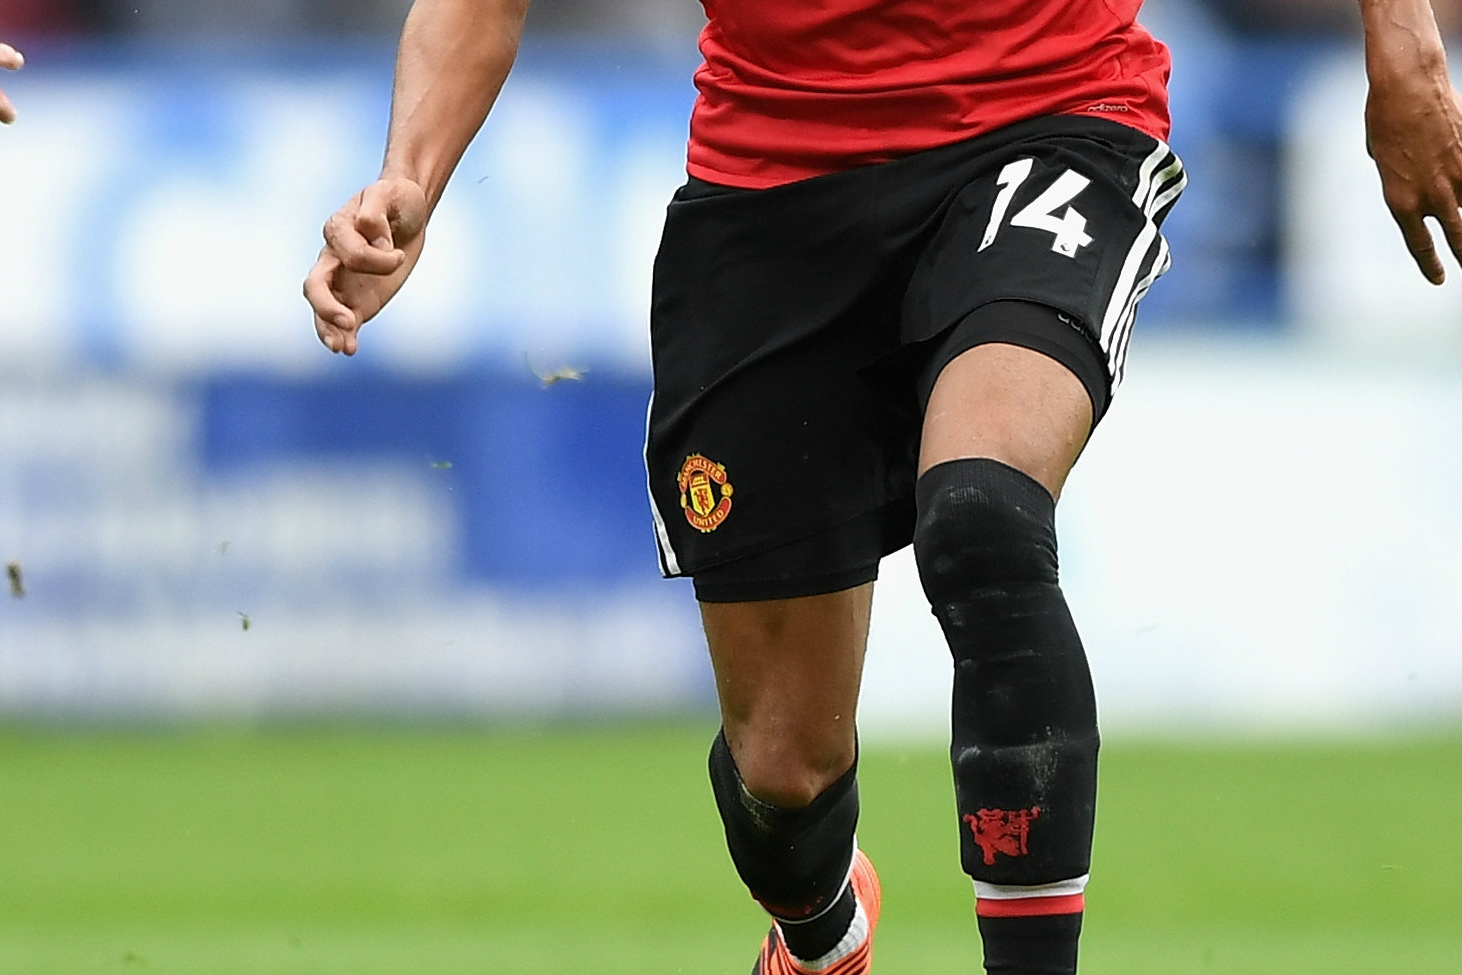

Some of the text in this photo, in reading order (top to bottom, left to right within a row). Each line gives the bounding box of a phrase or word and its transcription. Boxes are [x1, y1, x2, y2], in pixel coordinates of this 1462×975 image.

[976, 157, 1095, 260] 14
[681, 457, 724, 488] MANCHESTER
[692, 508, 725, 527] UNITED
